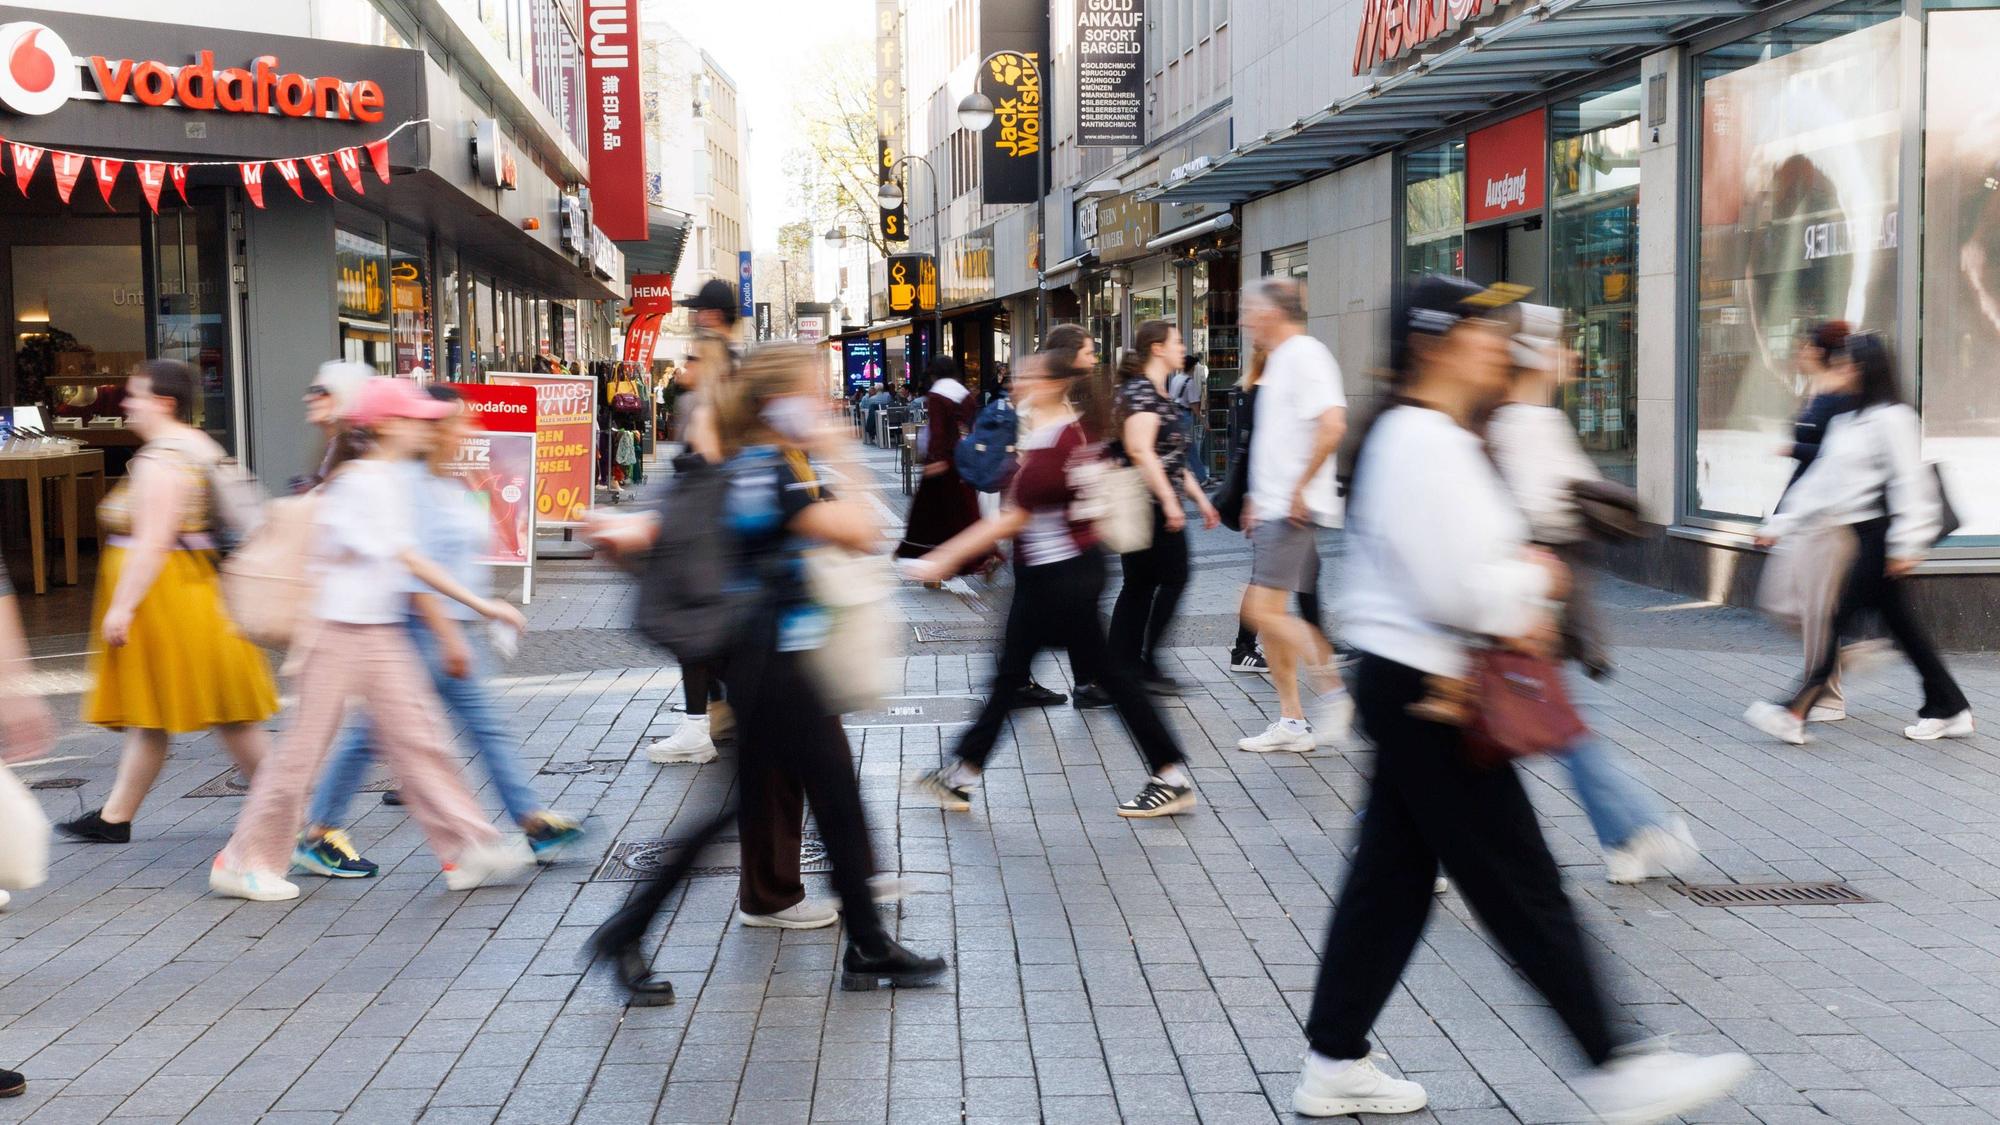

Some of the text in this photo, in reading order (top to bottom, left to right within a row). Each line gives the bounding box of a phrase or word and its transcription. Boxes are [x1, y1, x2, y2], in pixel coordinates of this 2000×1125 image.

[1088, 0, 1133, 11] GOLD
[1078, 12, 1143, 27] ANKAUF
[588, 0, 629, 68] UJI
[1085, 29, 1137, 42] SOFORT
[1081, 42, 1141, 54] BARGELD
[90, 50, 385, 123] vodafone
[1017, 52, 1039, 157] Wolfskin
[995, 97, 1018, 157] Jack
[1485, 168, 1526, 211] Ausgang
[633, 286, 671, 298] HEMA
[467, 400, 528, 414] vodafone
